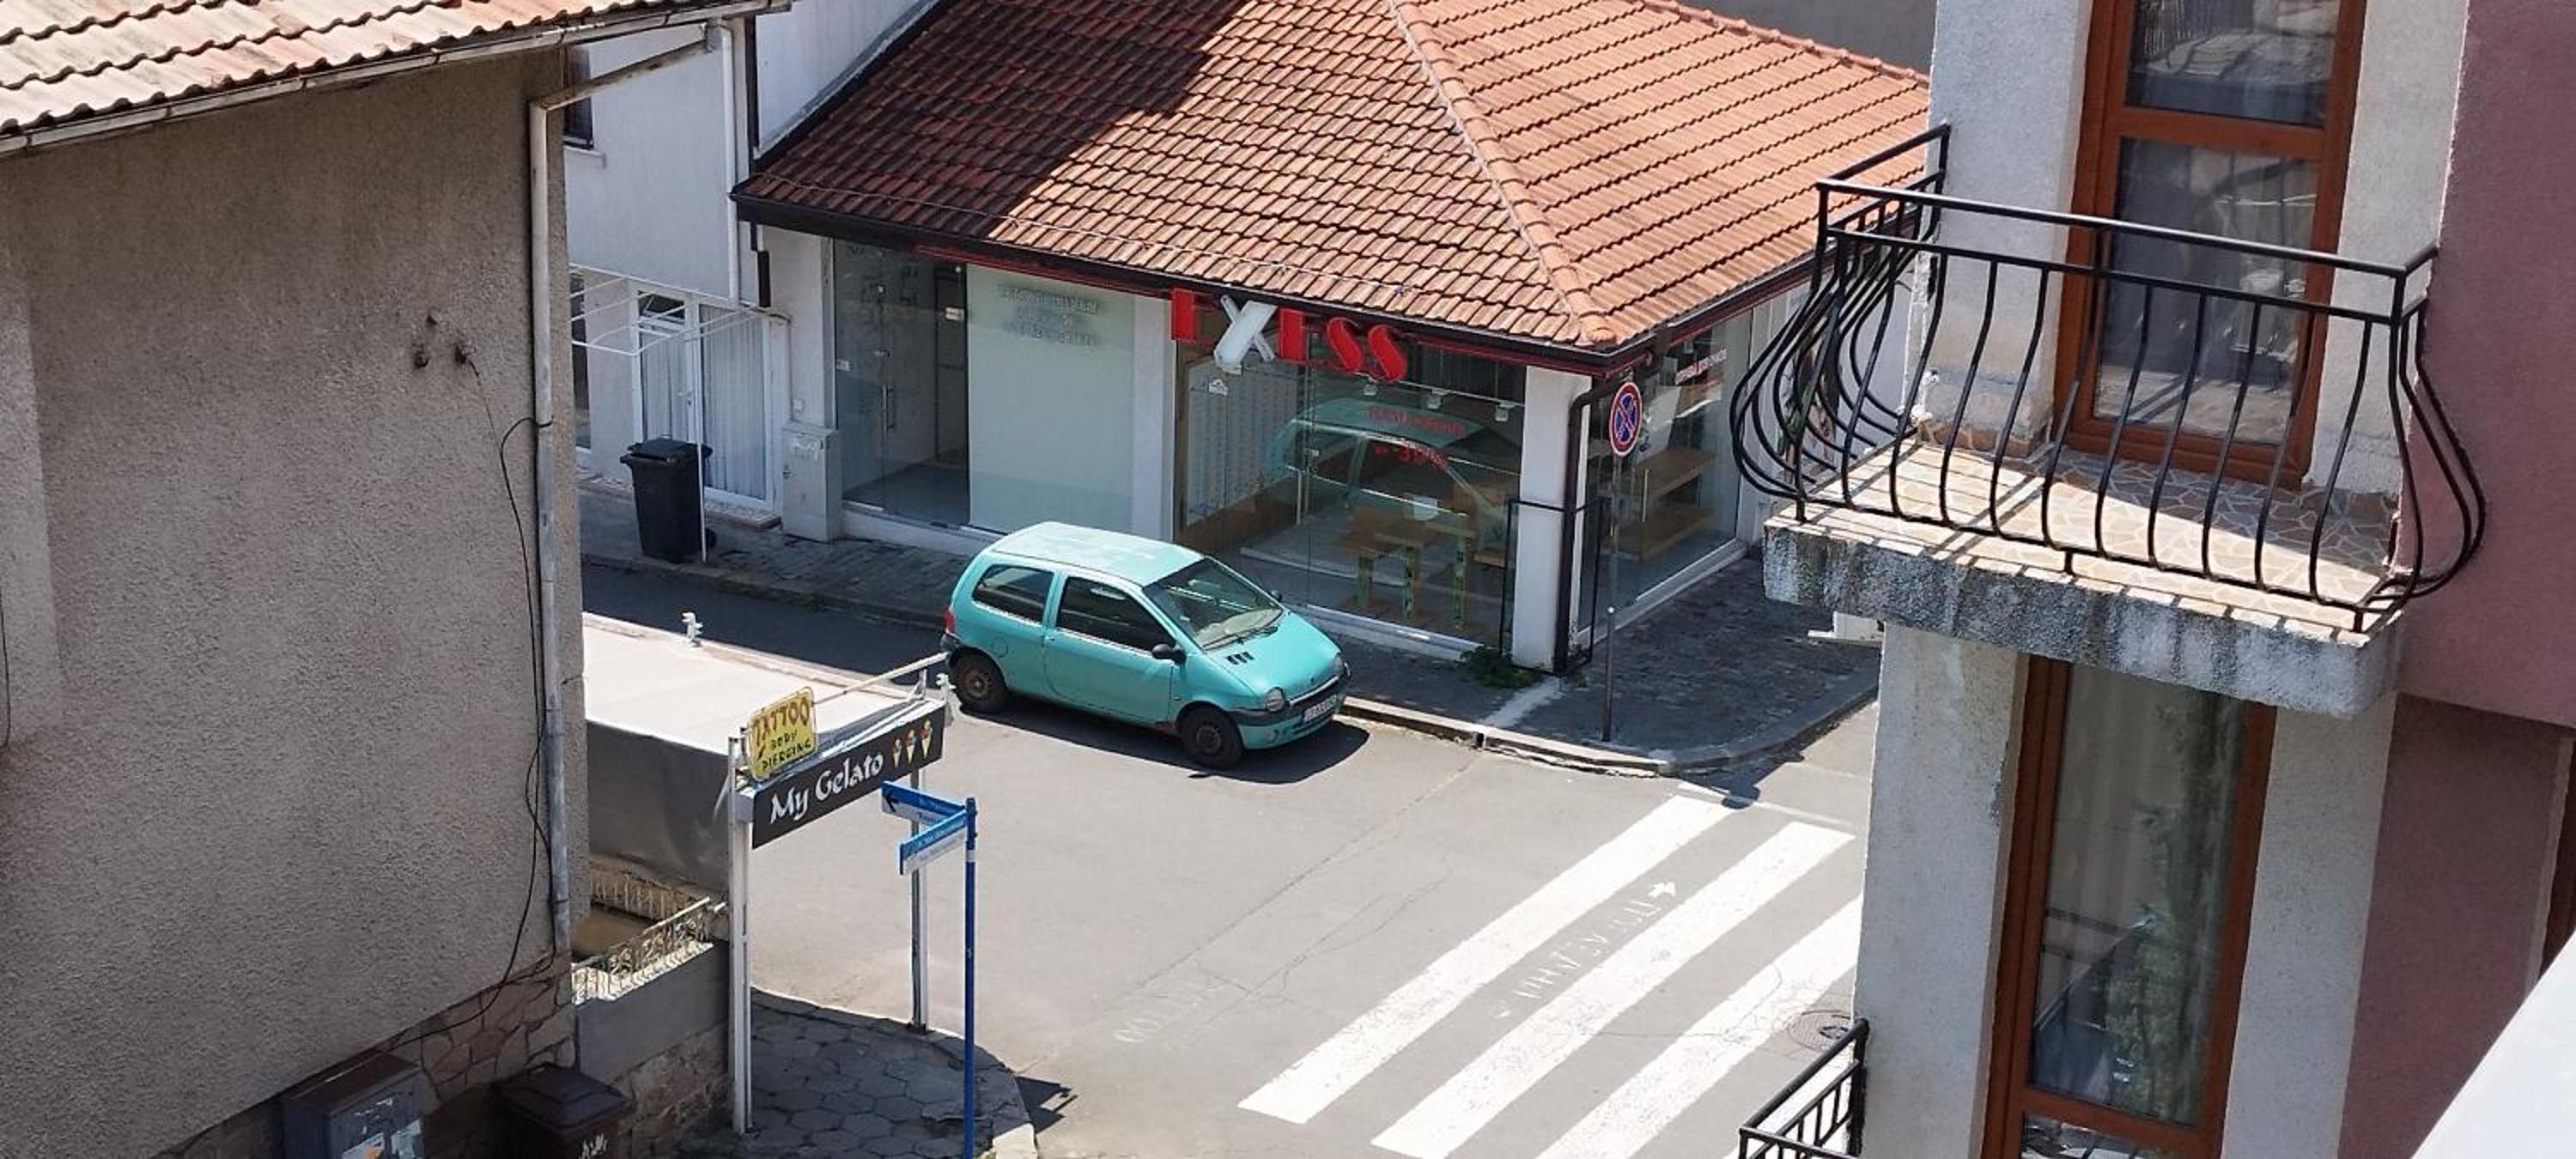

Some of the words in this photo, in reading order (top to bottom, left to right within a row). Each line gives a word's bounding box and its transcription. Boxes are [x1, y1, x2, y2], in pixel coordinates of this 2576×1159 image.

[1169, 288, 1407, 384] EXESS
[769, 786, 809, 825] My
[815, 753, 884, 801] Gelato
